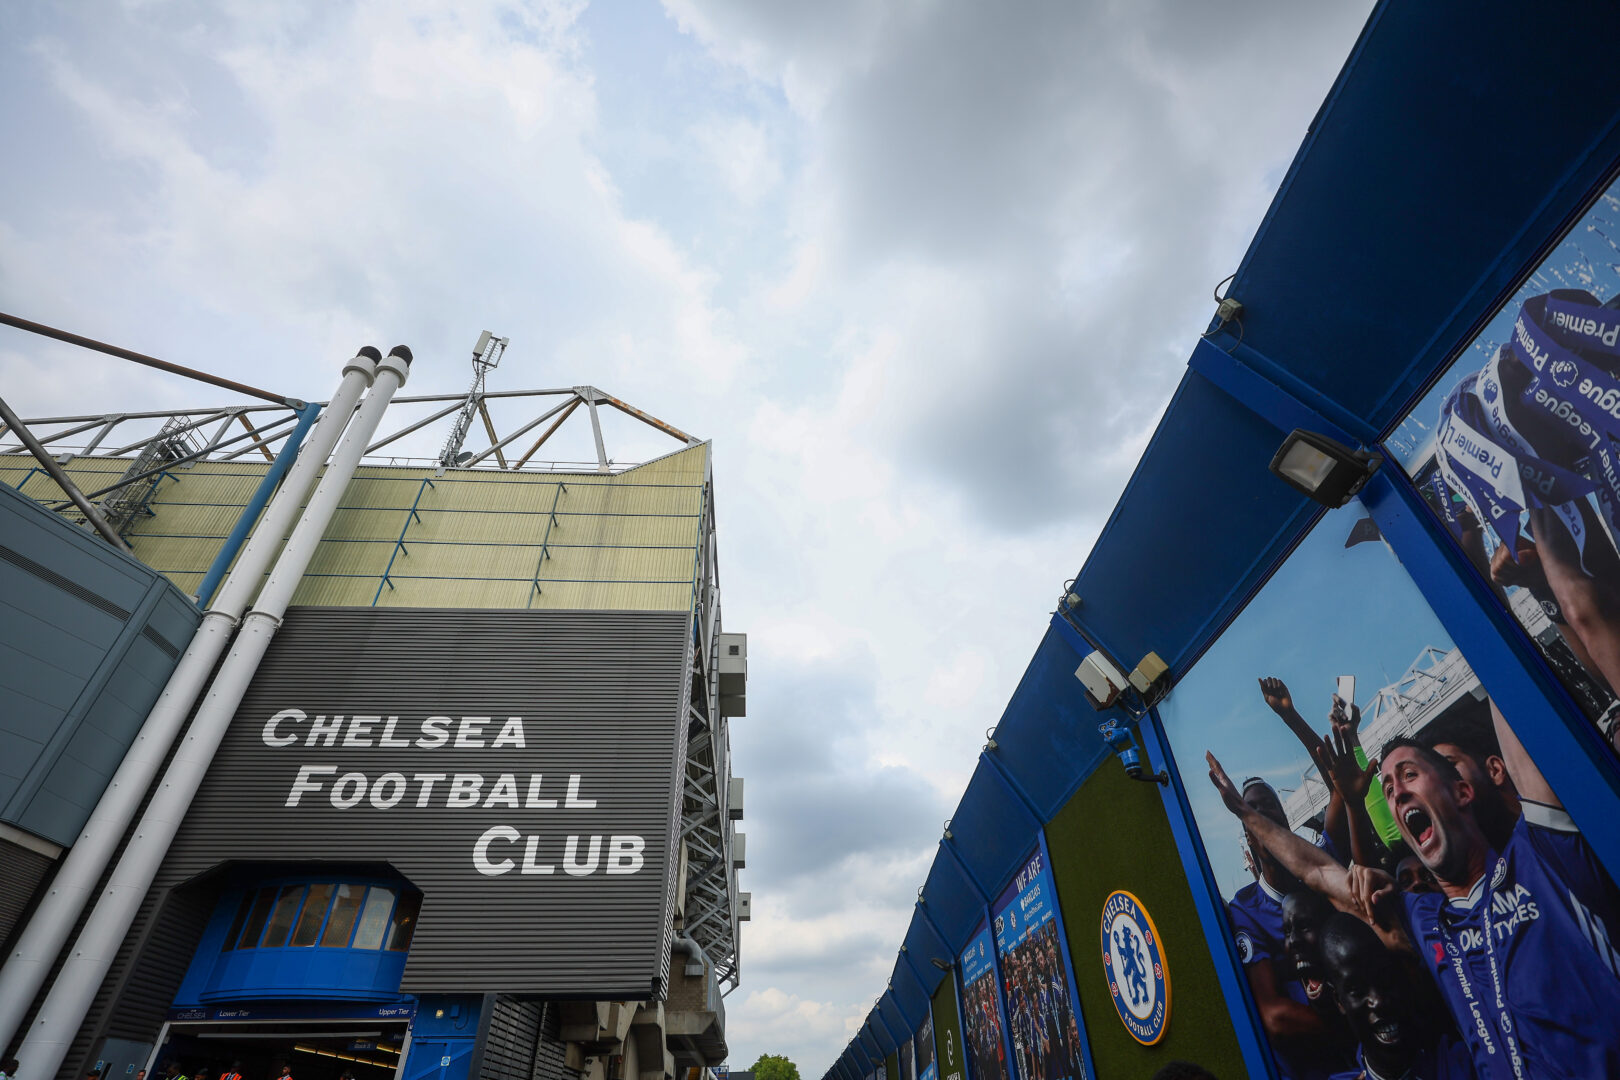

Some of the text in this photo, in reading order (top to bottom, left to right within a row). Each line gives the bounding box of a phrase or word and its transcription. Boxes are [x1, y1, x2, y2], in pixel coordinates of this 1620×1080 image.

[1550, 311, 1620, 347] Premier
[1535, 389, 1601, 450] League
[1454, 433, 1503, 479] Premier
[262, 709, 527, 749] CHELSEA
[284, 764, 598, 811] FOOTBALL
[472, 825, 647, 877] CLUB
[1103, 895, 1137, 935] CHELSEA
[219, 1009, 250, 1017] Lower Tier
[378, 1008, 410, 1016] Upper Tier
[1124, 1000, 1164, 1037] FOOTBALL CLUB
[1451, 957, 1496, 1055] Premier League
